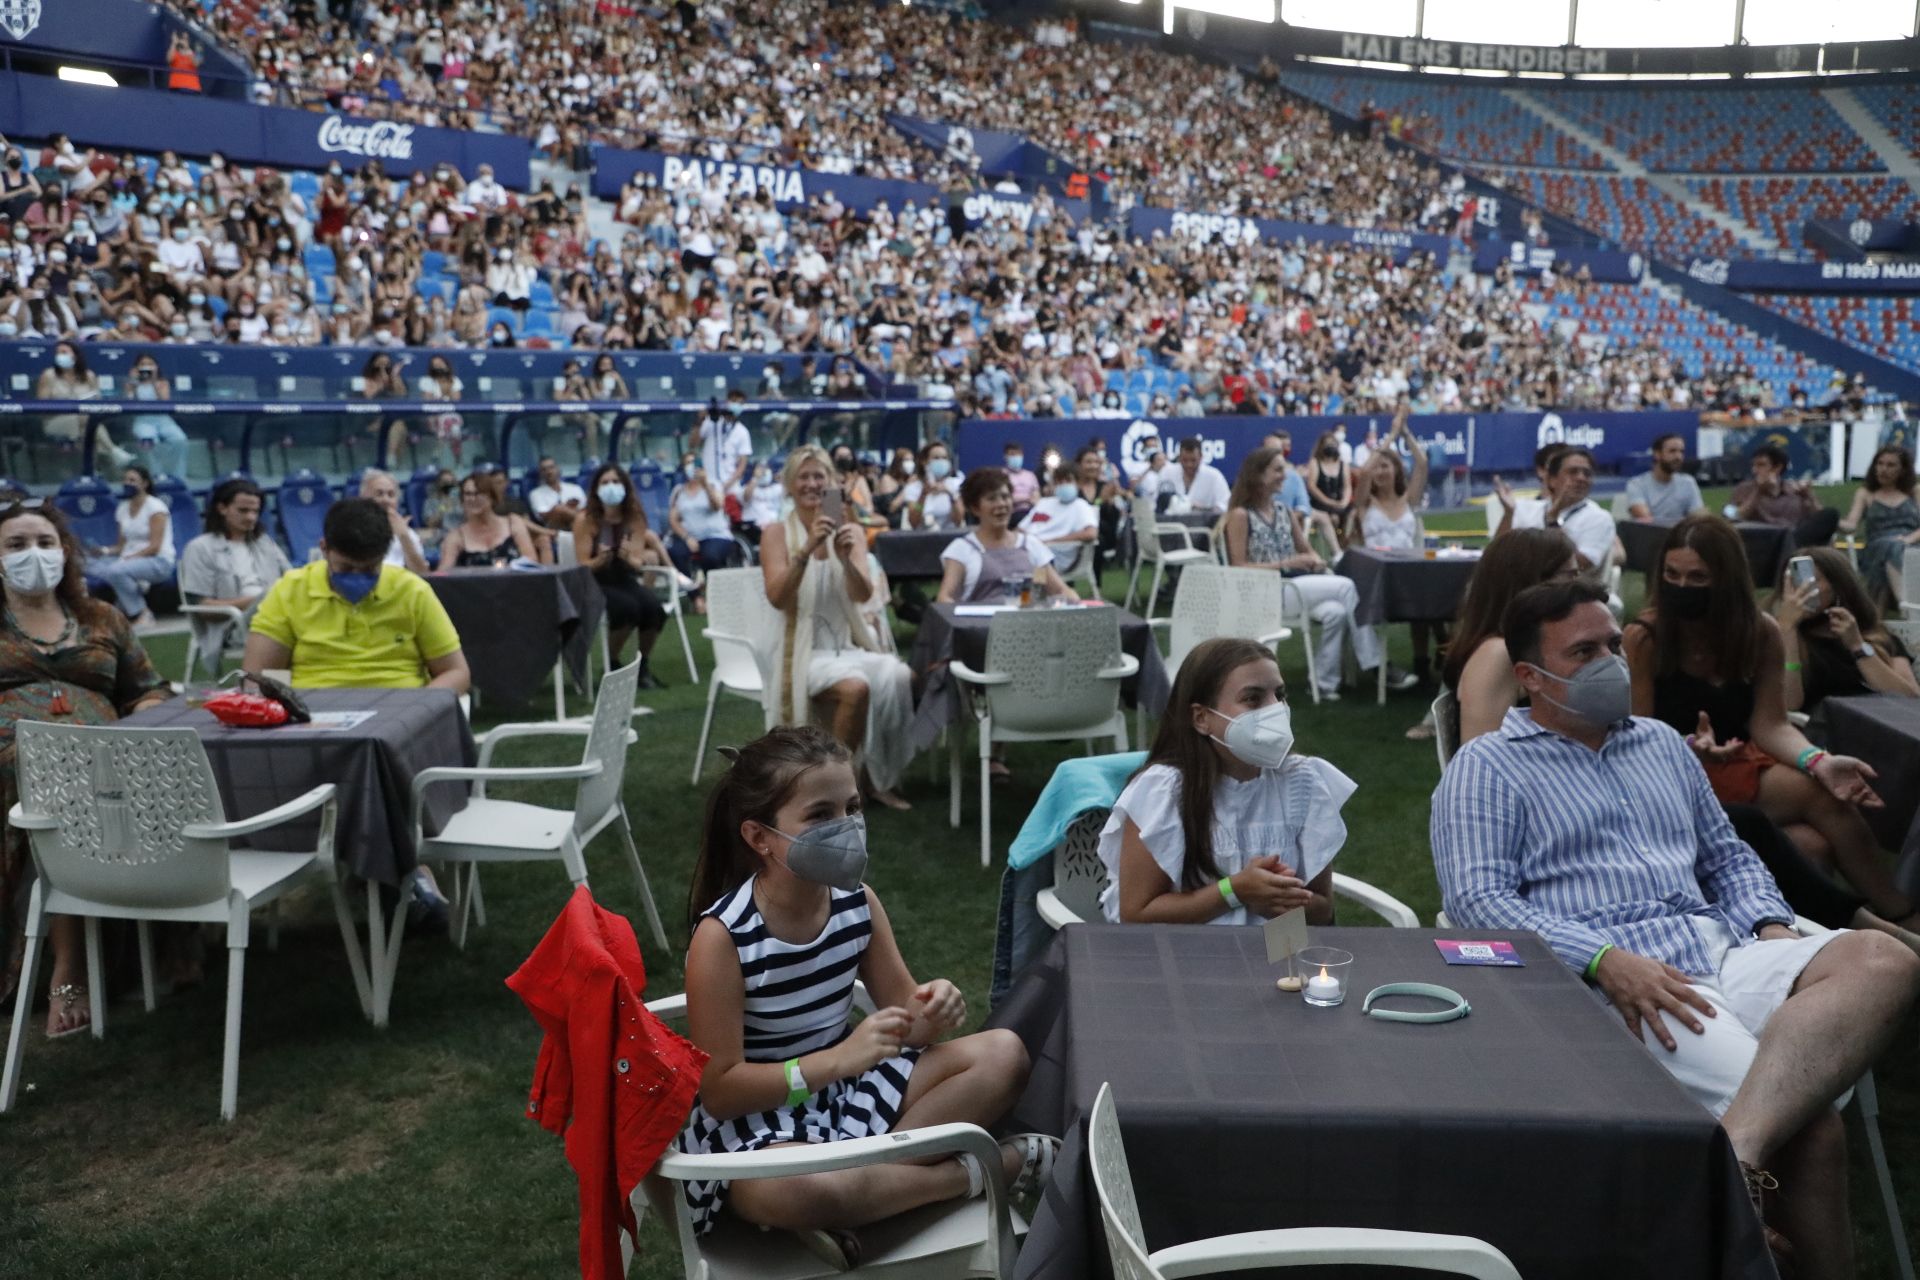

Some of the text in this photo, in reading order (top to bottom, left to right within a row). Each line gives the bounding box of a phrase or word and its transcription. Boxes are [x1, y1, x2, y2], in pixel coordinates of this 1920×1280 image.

[1341, 34, 1608, 71] MAI ENS RENDIREM
